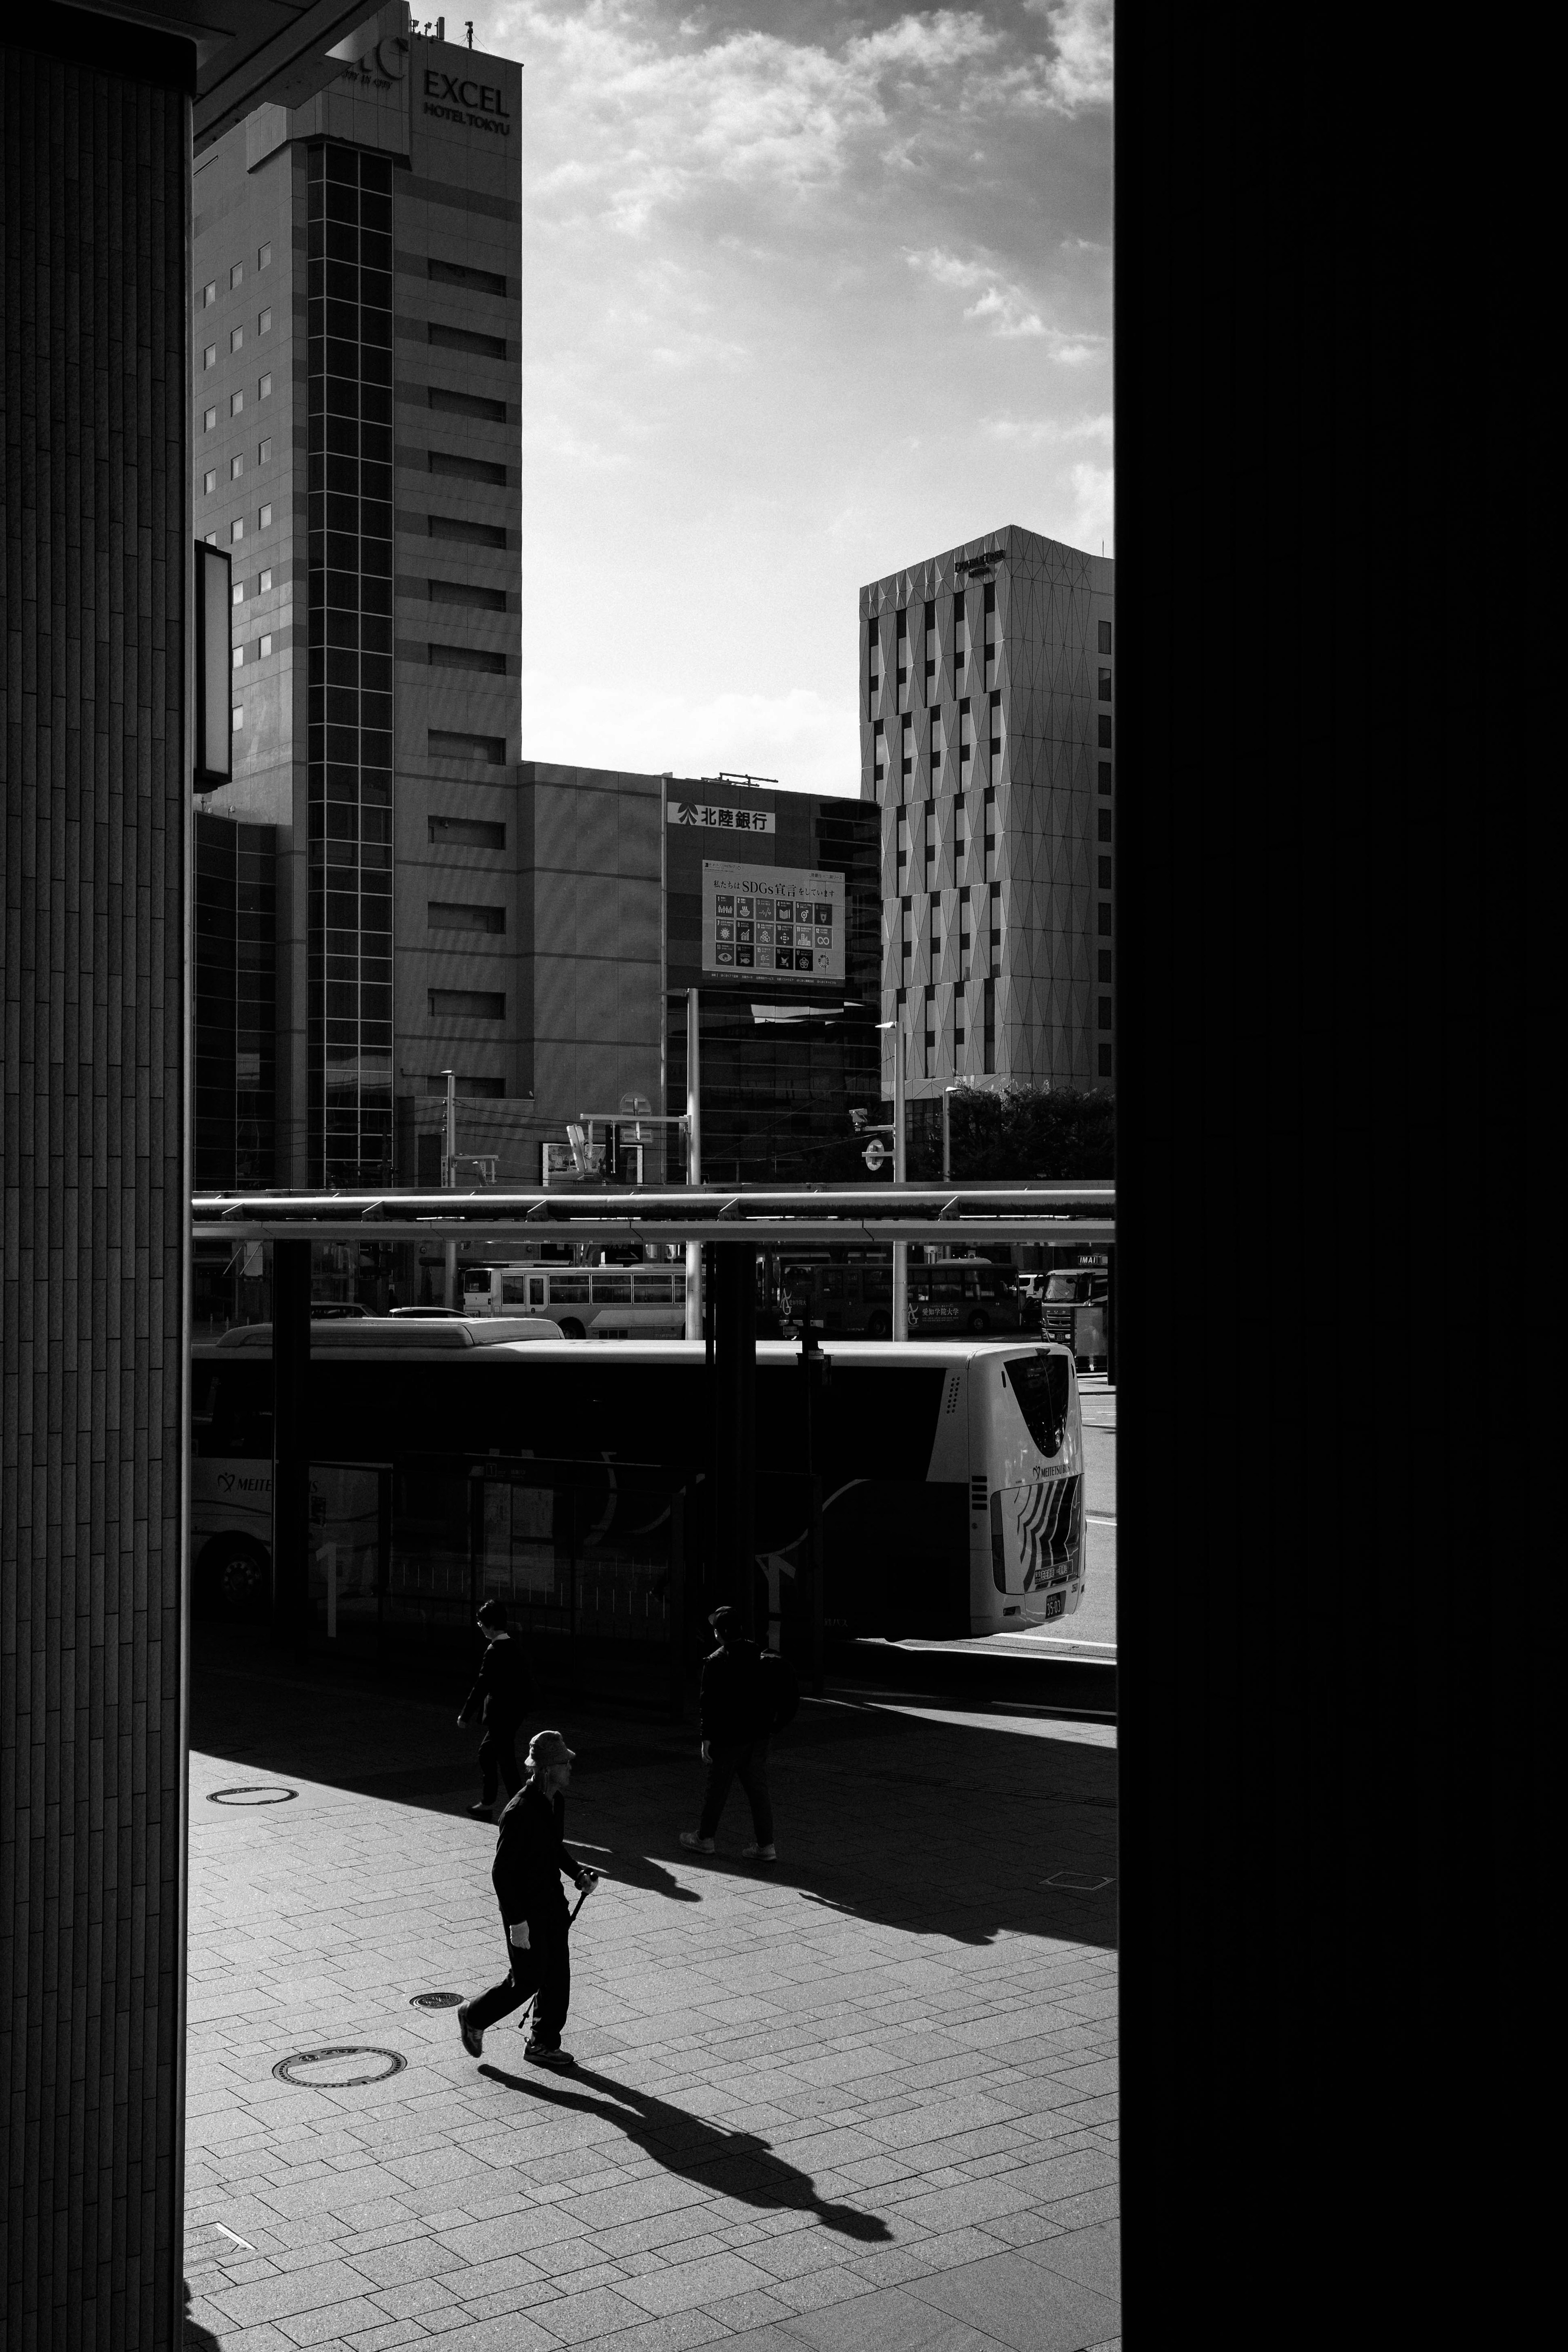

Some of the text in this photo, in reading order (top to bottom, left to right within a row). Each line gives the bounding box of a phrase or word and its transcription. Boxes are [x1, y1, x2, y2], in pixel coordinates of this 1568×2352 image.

[424, 69, 510, 118] EXCEL
[424, 102, 510, 136] HOTEL TOKYU
[701, 807, 767, 831] 北陸銀行
[922, 1307, 959, 1316] 愛知学院大学
[1041, 1465, 1062, 1478] MEITETSU
[237, 1478, 272, 1491] MEITE
